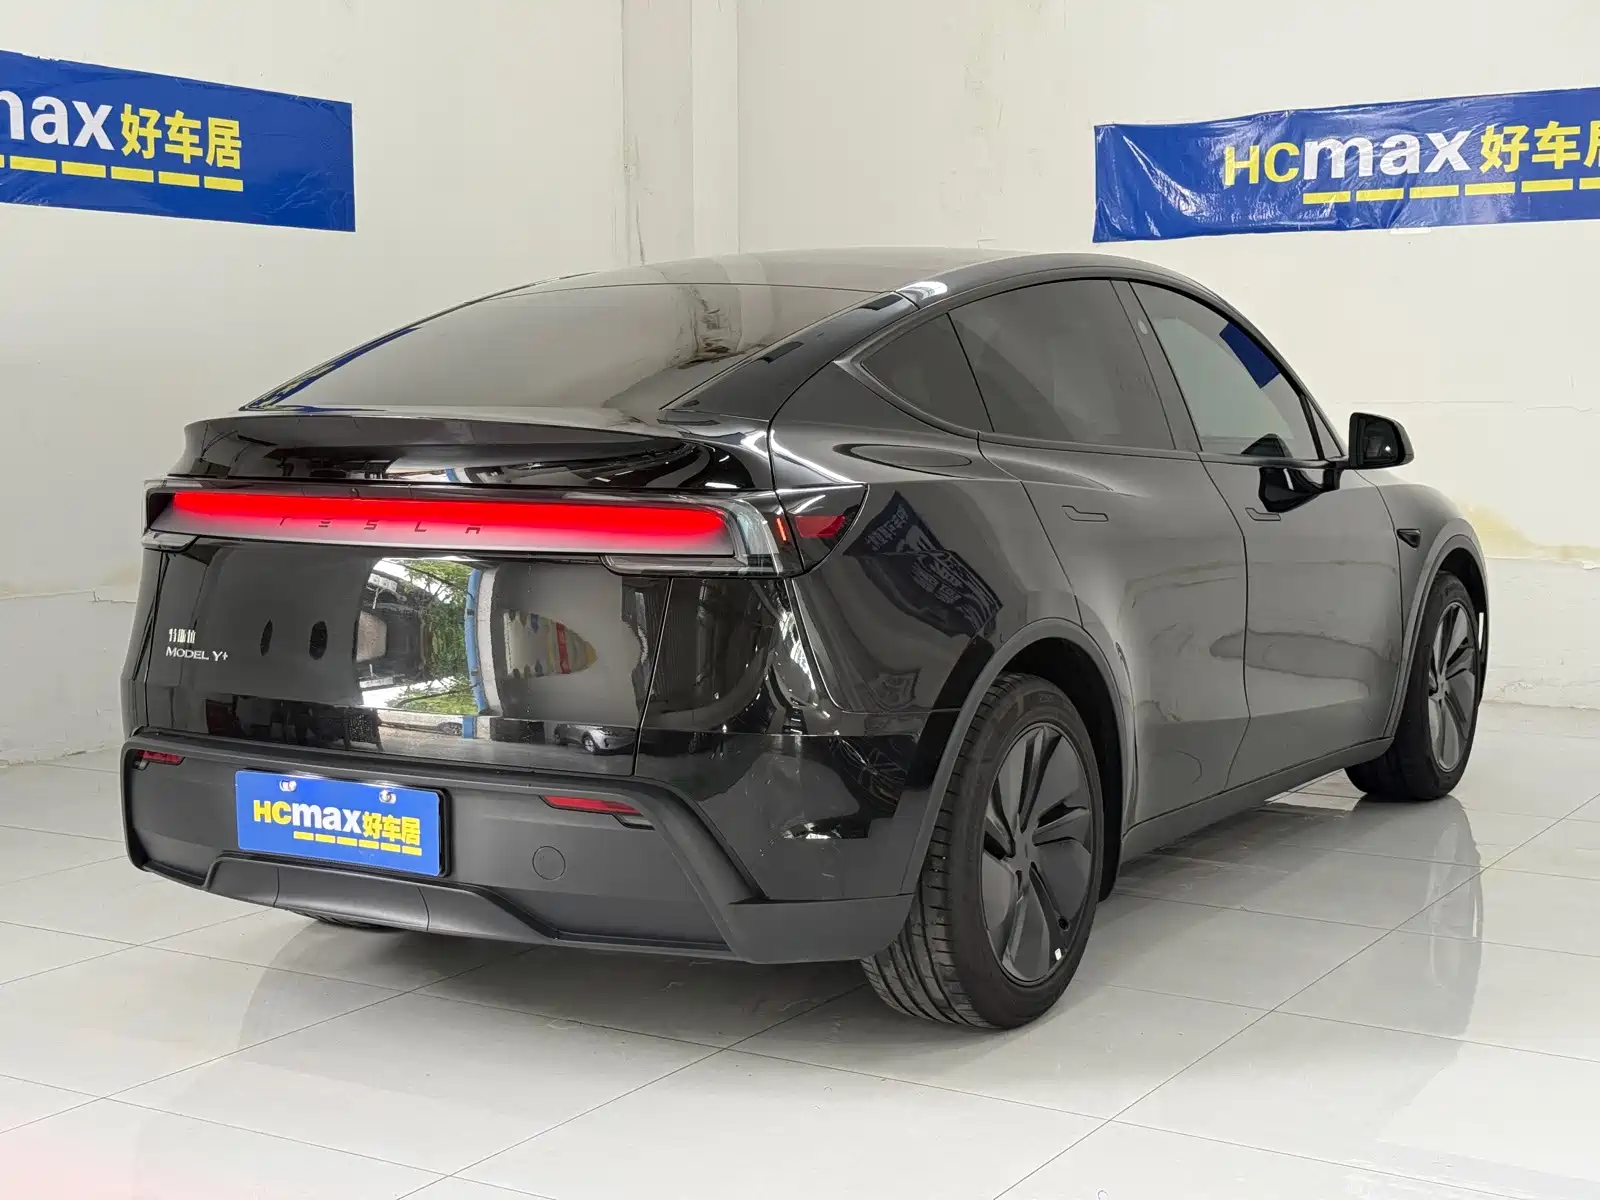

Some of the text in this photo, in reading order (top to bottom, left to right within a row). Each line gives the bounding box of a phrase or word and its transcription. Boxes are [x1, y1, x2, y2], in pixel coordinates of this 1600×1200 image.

[120, 103, 243, 170] 好车居
[1223, 130, 1472, 186] HCmax
[279, 516, 482, 535] TESLA
[165, 646, 209, 661] MODEL
[253, 799, 421, 846] HCmax 好车居
